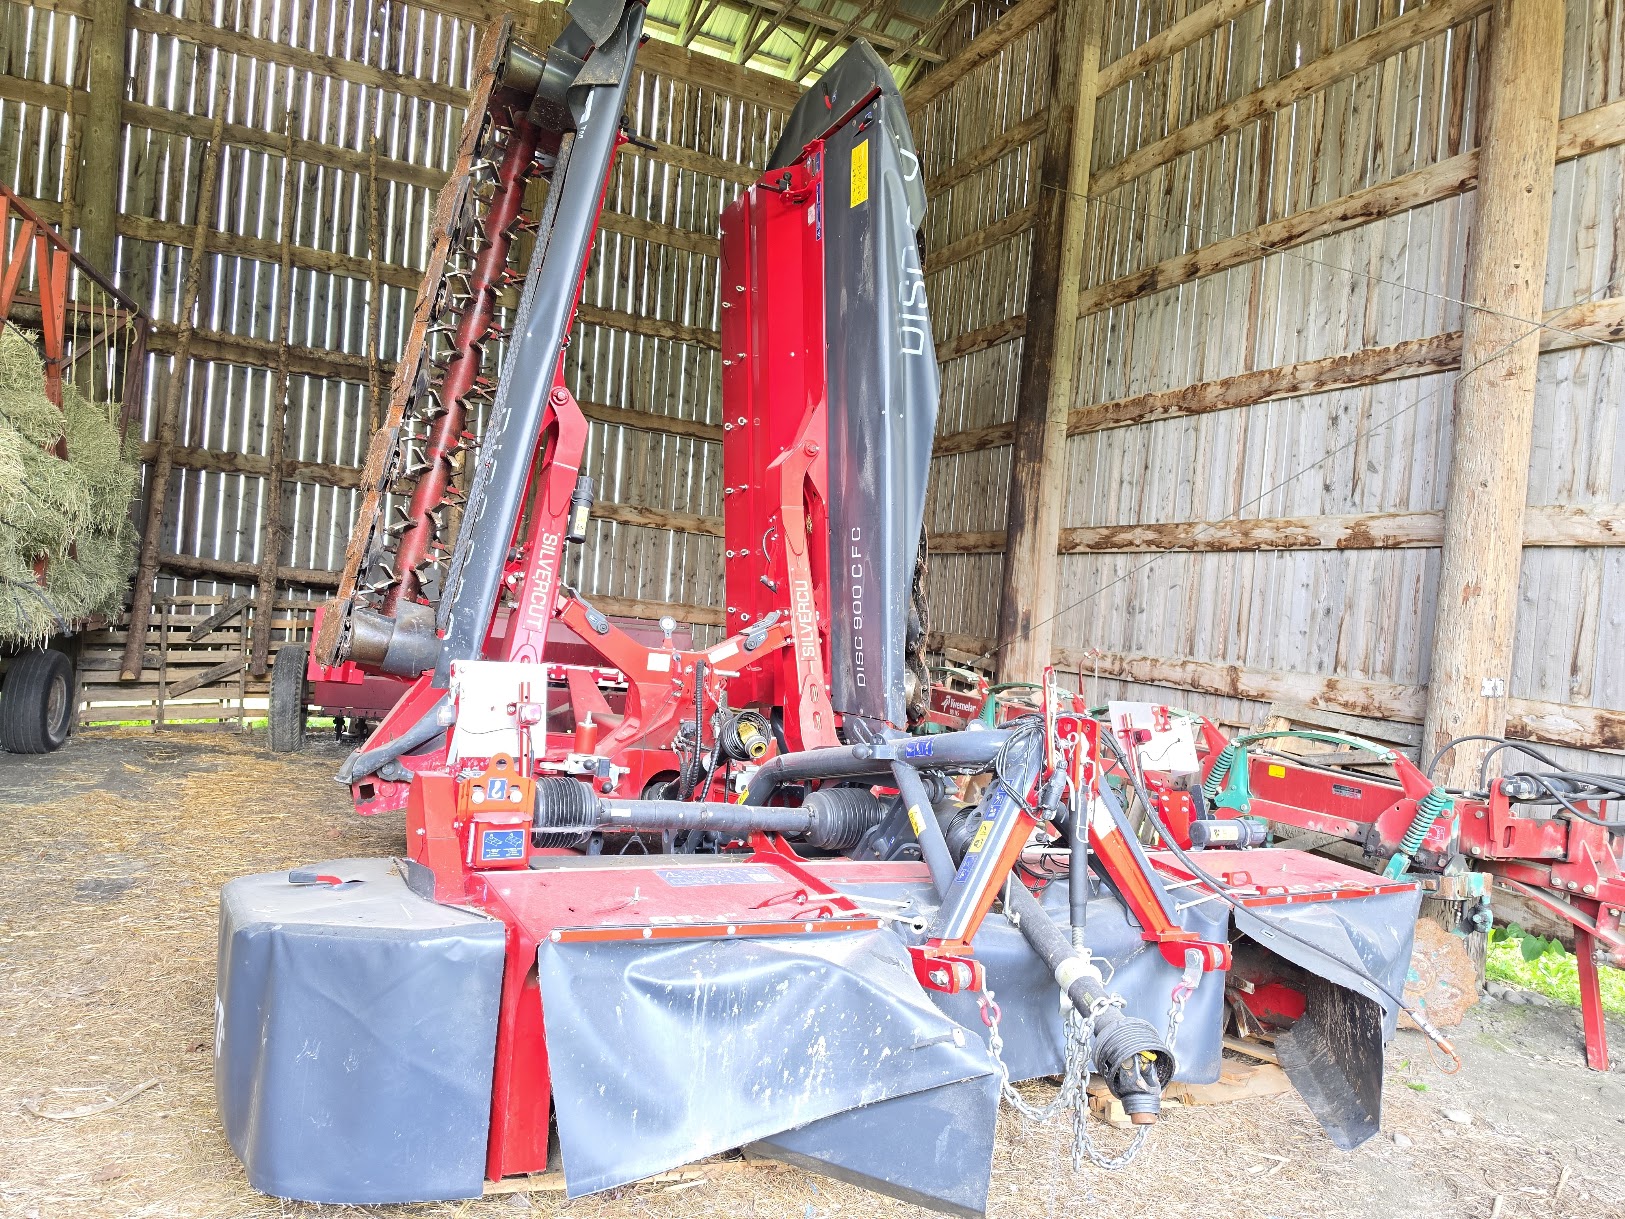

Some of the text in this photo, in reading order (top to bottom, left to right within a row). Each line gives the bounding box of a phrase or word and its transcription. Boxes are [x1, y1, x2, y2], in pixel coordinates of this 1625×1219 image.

[526, 533, 558, 630] SILVERCUT
[851, 585, 863, 630] 900
[854, 636, 866, 687] DISC
